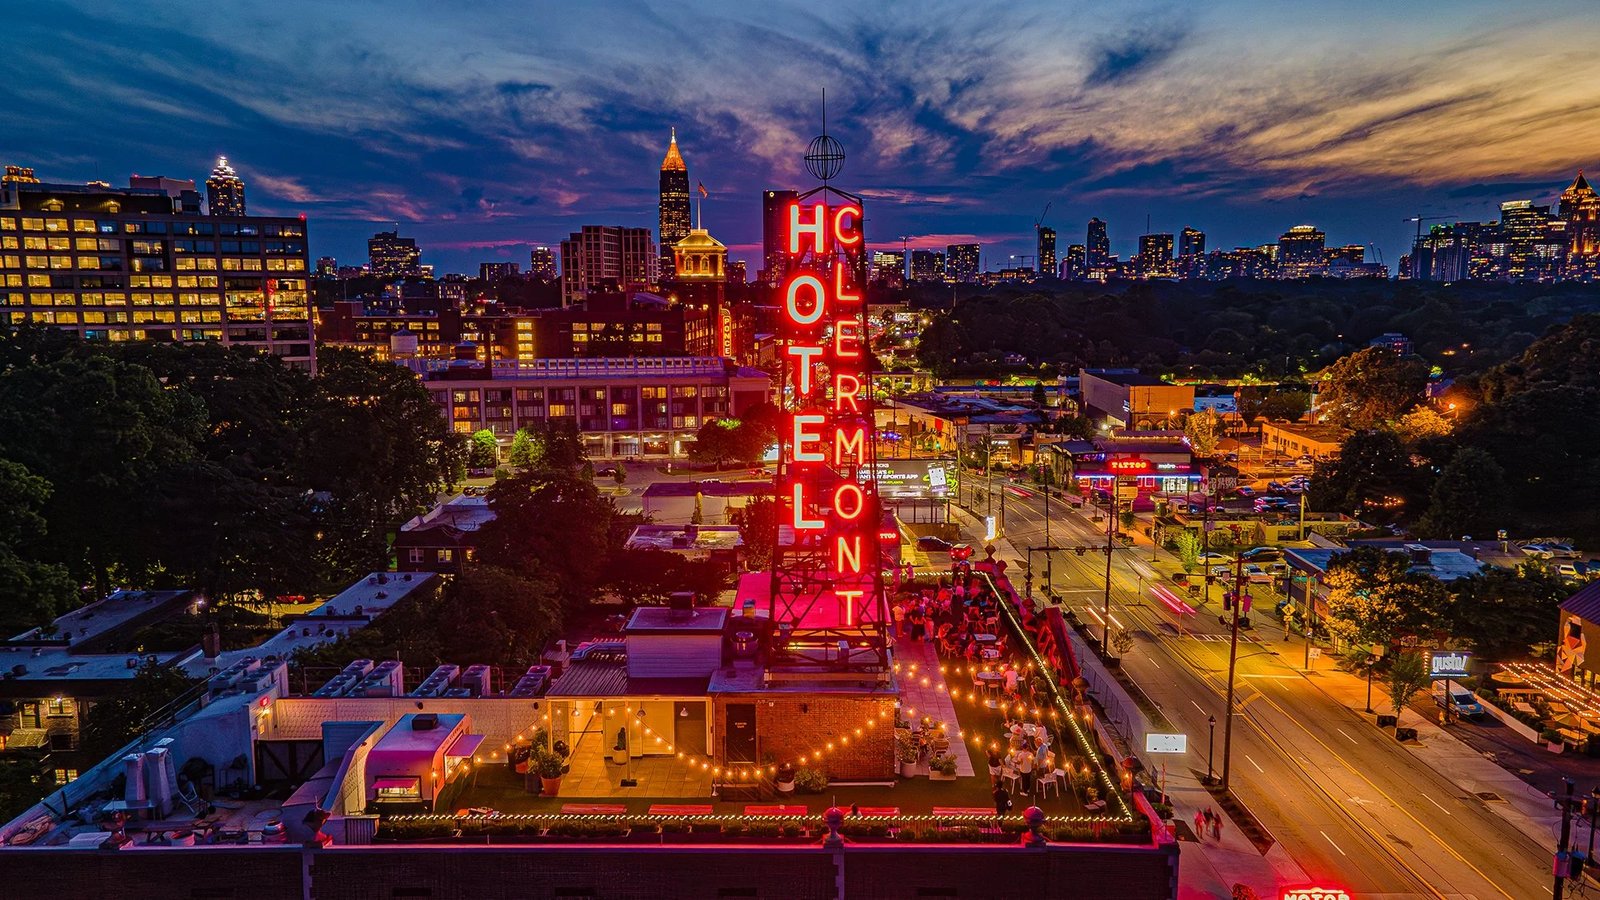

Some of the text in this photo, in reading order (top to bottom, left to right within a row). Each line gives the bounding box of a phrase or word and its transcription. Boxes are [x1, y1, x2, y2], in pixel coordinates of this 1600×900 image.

[787, 204, 826, 529] HOTEL
[834, 207, 864, 625] CLERMONT
[1111, 461, 1147, 469] TATTOO
